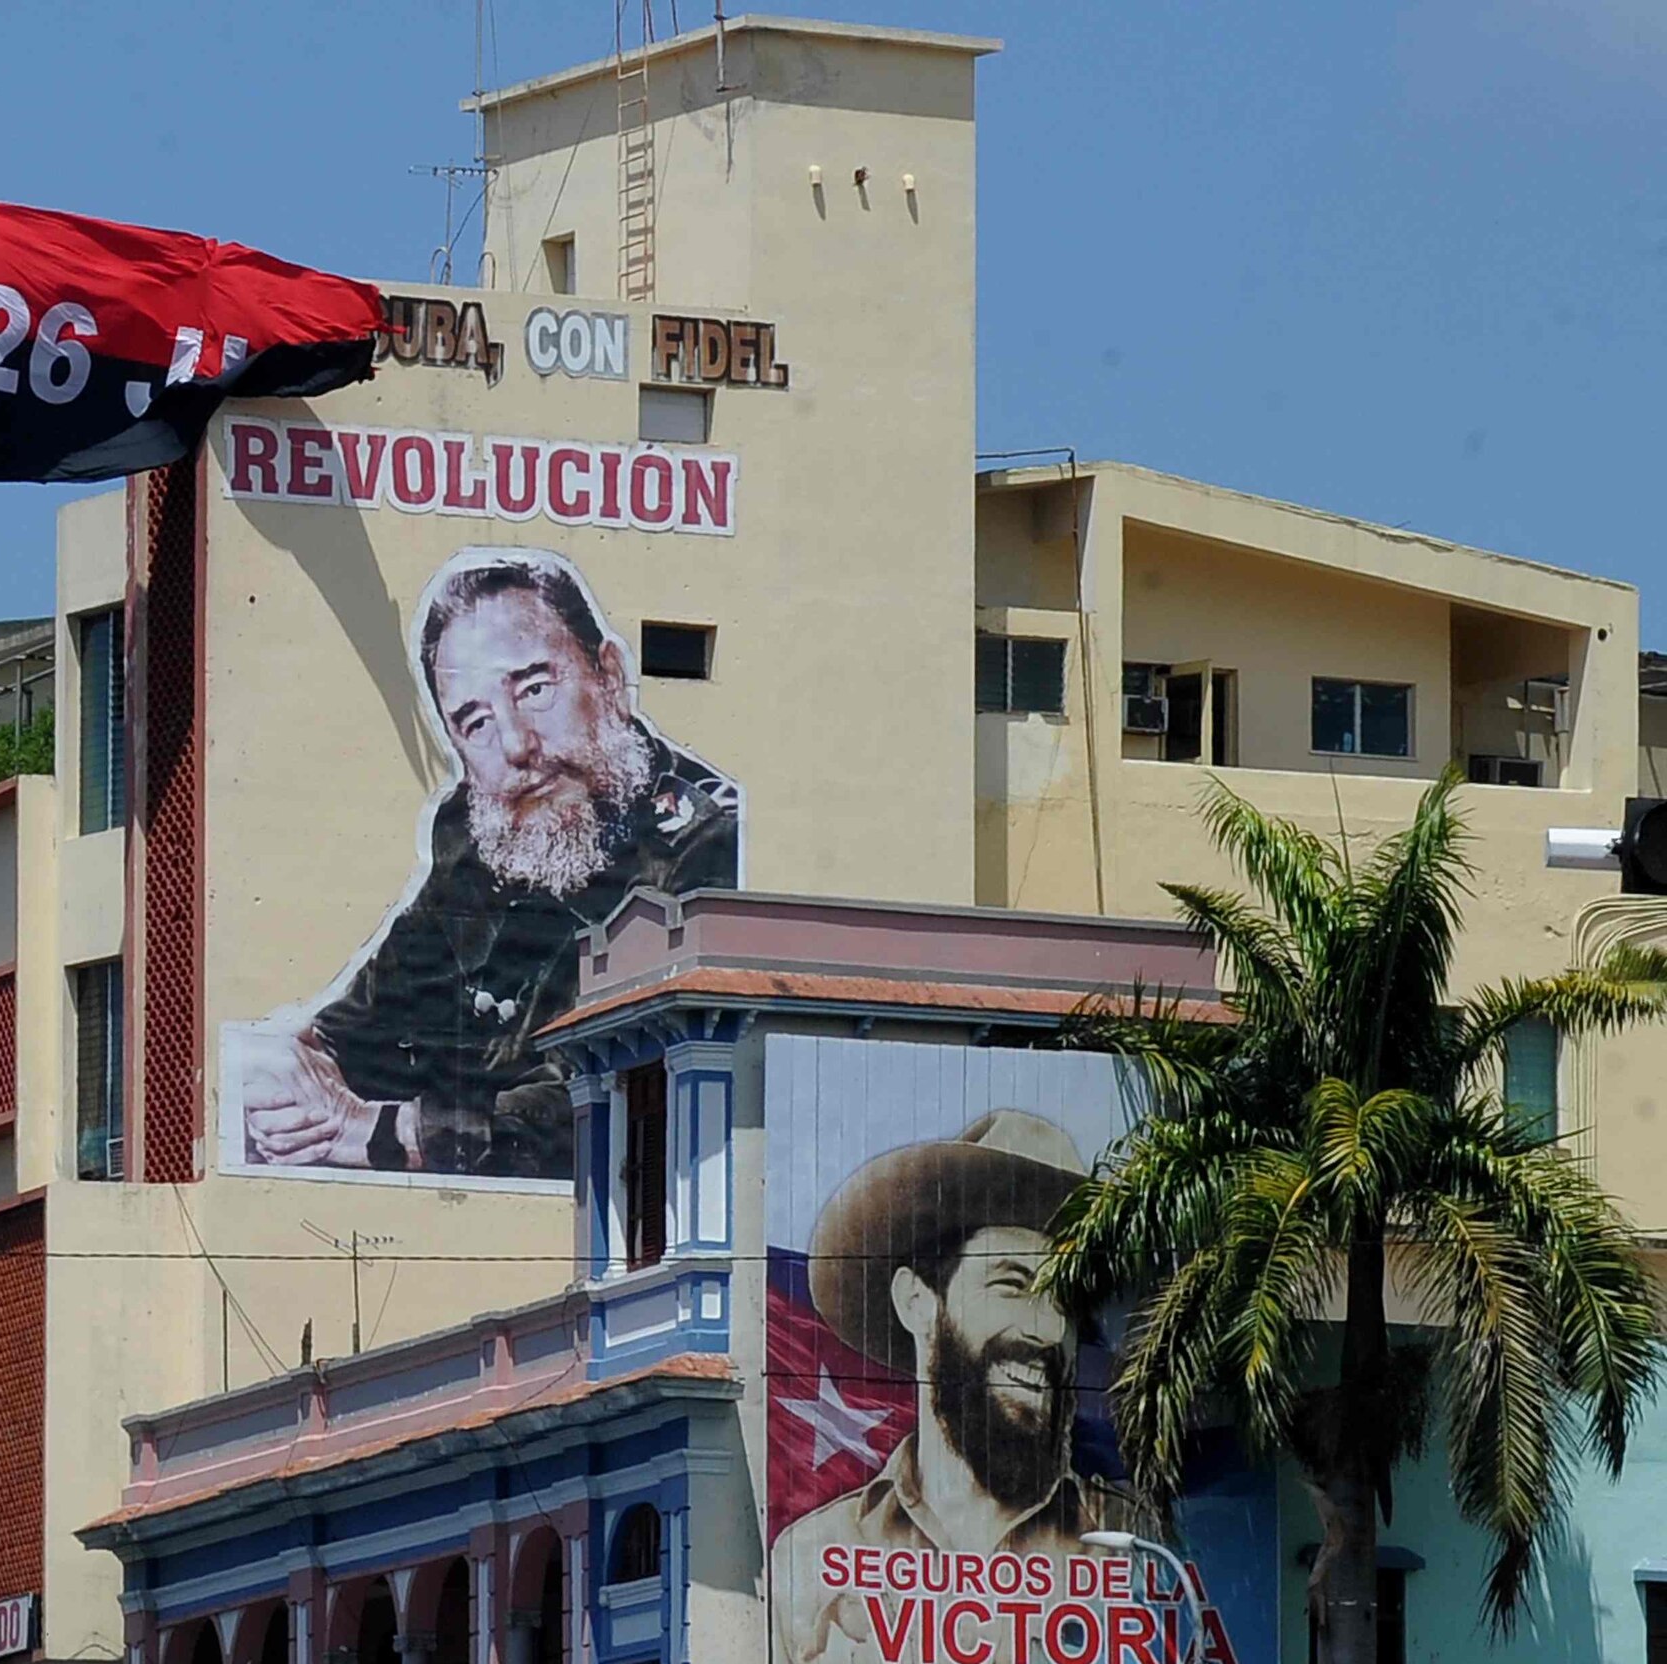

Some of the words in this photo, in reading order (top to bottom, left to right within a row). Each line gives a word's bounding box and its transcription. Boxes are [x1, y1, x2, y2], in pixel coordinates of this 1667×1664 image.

[527, 308, 627, 376] CON
[652, 314, 787, 388] FIDEL
[229, 420, 734, 530] REVOLUCIÓN
[821, 1546, 1053, 1597] SEGUROS
[1068, 1557, 1130, 1599] DE
[1145, 1560, 1207, 1602] LA
